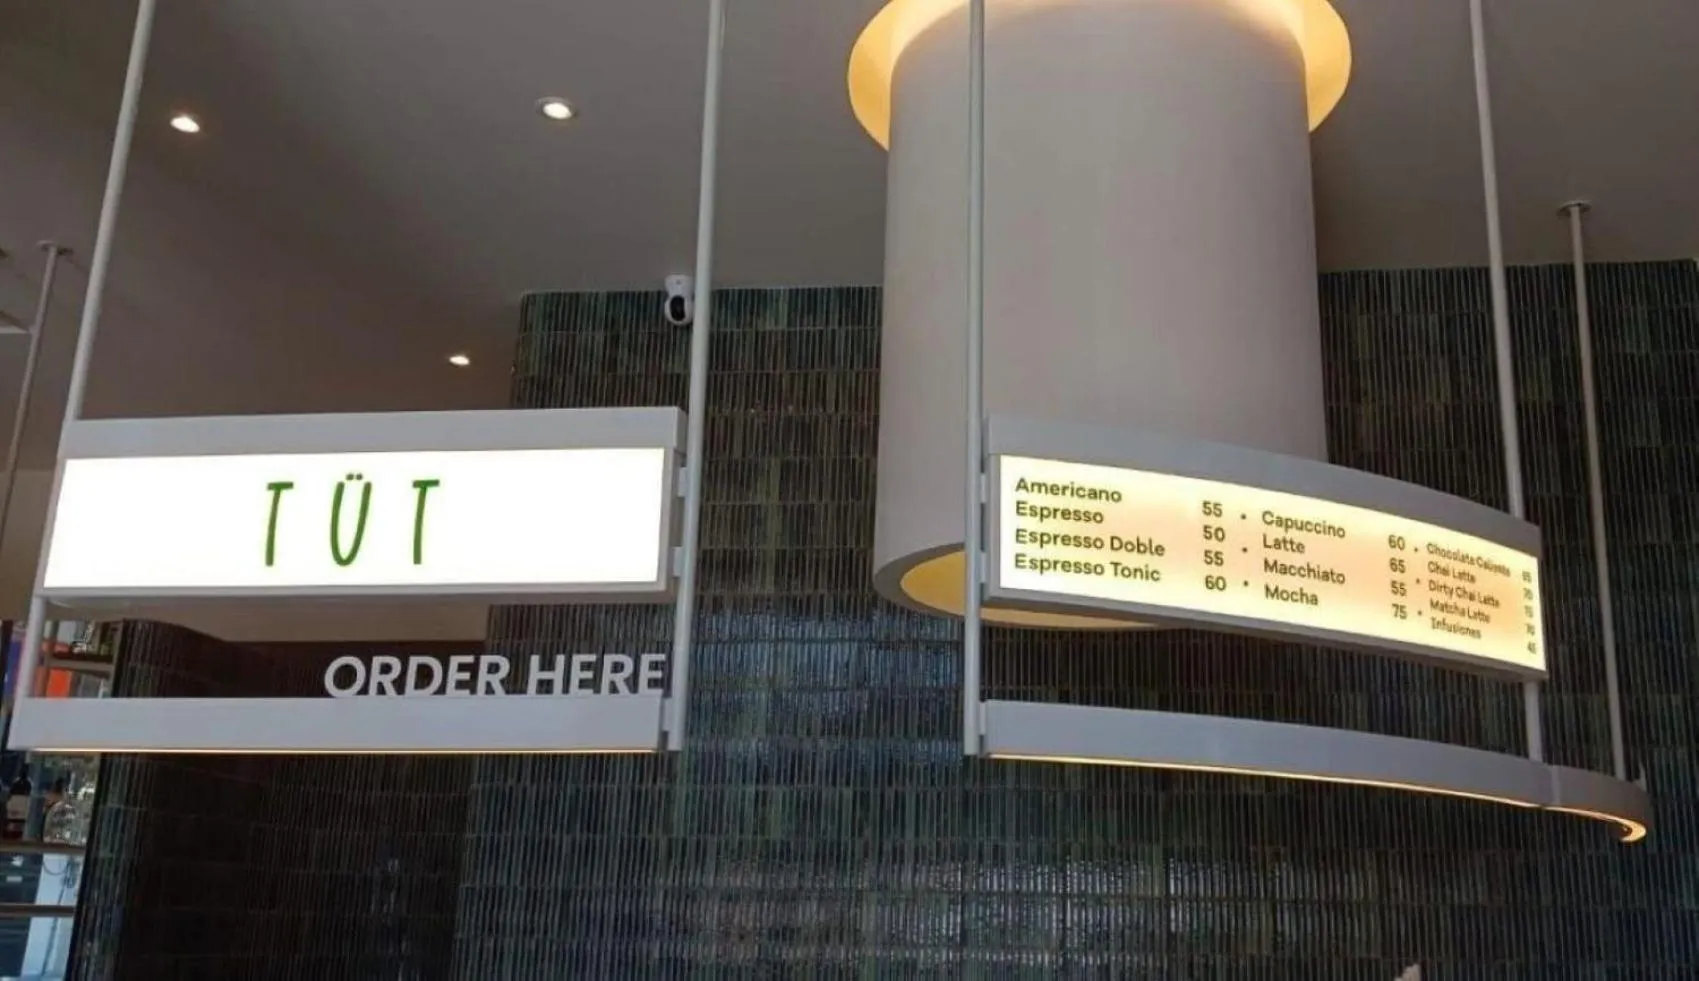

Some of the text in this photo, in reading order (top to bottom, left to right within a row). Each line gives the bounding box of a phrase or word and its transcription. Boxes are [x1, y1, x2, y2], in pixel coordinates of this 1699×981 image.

[1015, 477, 1222, 517] Americano 55
[1015, 500, 1225, 541] Espresso 50
[1262, 510, 1405, 551] Capuccino 60
[1015, 528, 1224, 566] Espresso Doble 55
[1262, 534, 1406, 574] Latte 65
[1015, 553, 1226, 591] Espresso Tonic 60
[1263, 558, 1407, 597] Macchiato 55
[1428, 561, 1450, 576] Chai
[1452, 568, 1476, 583] Latte
[1264, 584, 1407, 620] Mocha 75
[1428, 580, 1453, 598] Dirty
[1455, 586, 1475, 601] Chai
[1478, 592, 1500, 608] Latte
[1430, 598, 1466, 616] Matcha
[1467, 606, 1490, 624] Latte
[1430, 616, 1482, 639] Infusiones
[324, 653, 666, 697] ORDER HERE
